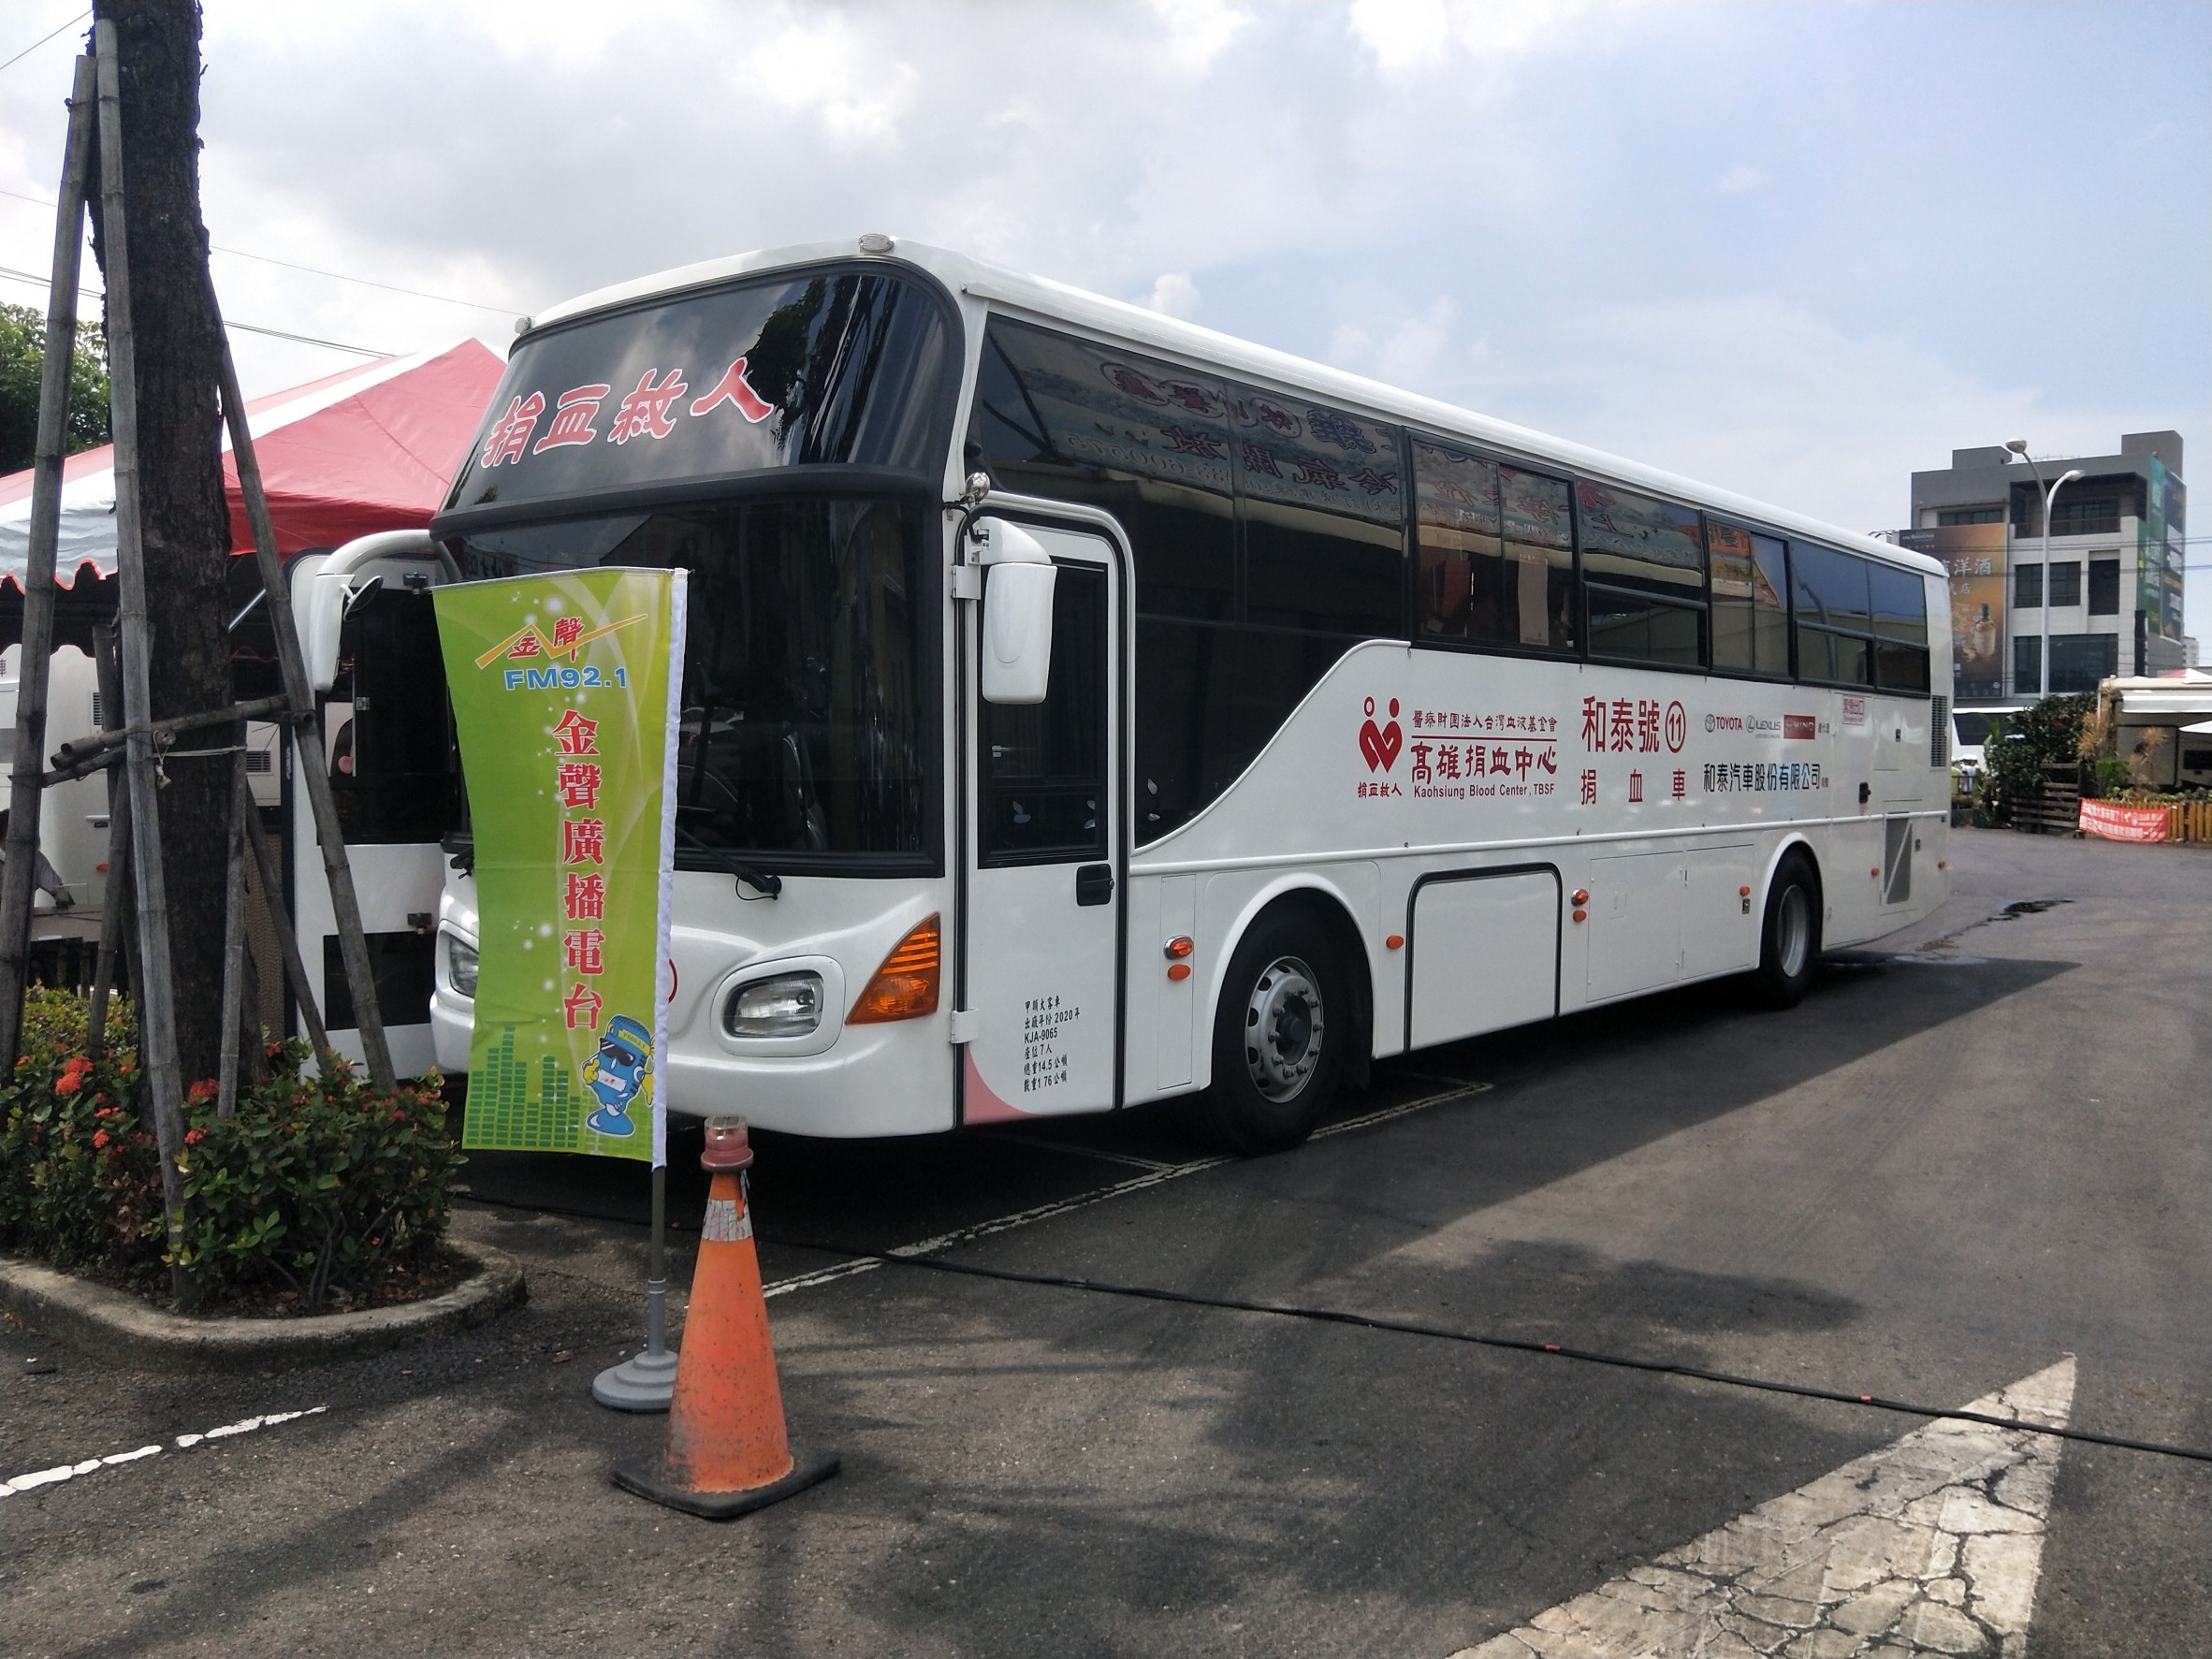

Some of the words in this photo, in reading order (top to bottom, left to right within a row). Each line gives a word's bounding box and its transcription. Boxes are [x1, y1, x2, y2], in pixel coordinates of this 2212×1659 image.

[481, 357, 774, 468] 捐血救人
[503, 666, 627, 691] FM92.1
[1412, 710, 1558, 733] 醫療財團法人台灣血液基金會
[1581, 695, 1660, 753] 和泰號
[1716, 716, 1742, 731] TOYOTA
[1410, 741, 1558, 784] 高雄捐血中心
[1414, 785, 1464, 800] Kaohsiung
[1469, 784, 1495, 796] Blood
[1534, 782, 1555, 795] TBSF
[1703, 763, 1821, 793] 和泰汽車股份有限公司
[551, 708, 606, 1030] 金聲廣播電台
[1024, 1027, 1058, 1044] KJA-9065
